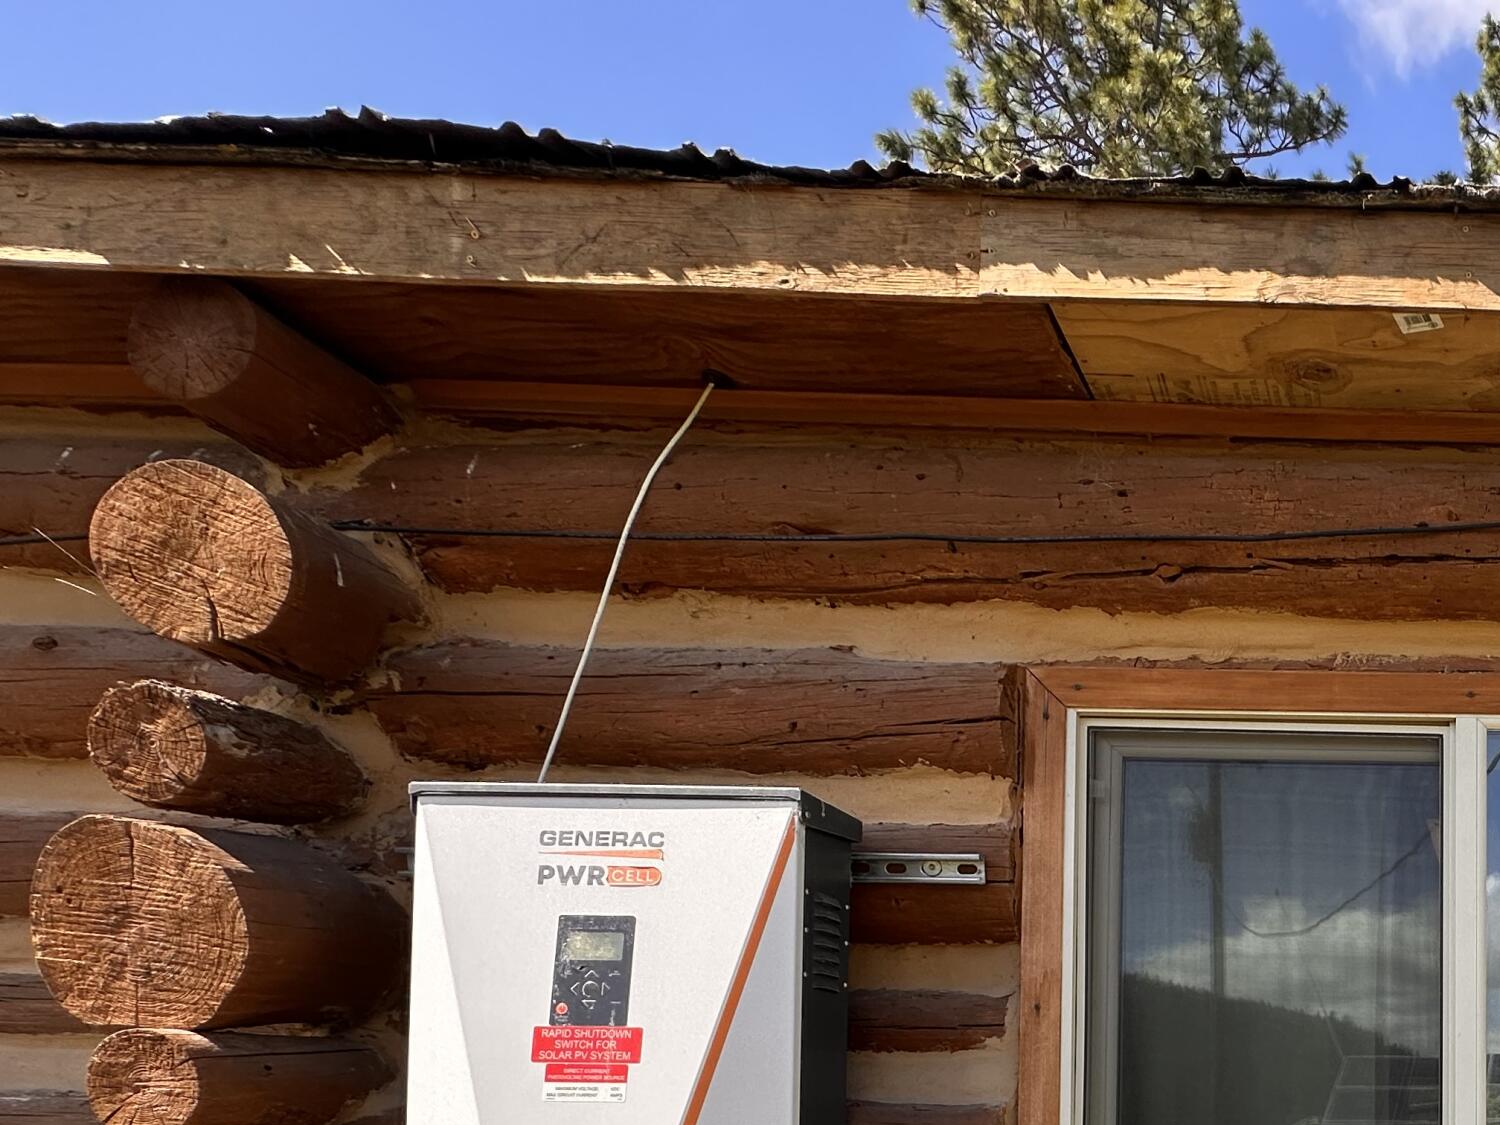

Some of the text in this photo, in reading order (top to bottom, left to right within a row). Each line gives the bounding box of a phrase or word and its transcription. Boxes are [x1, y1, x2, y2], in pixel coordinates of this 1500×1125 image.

[540, 830, 665, 848] GENERAC
[541, 1029, 632, 1039] RAPID SHUTDOWN
[554, 1040, 617, 1050] SWITCH FOR
[538, 1051, 632, 1061] SOLAR PV SYSTEM
